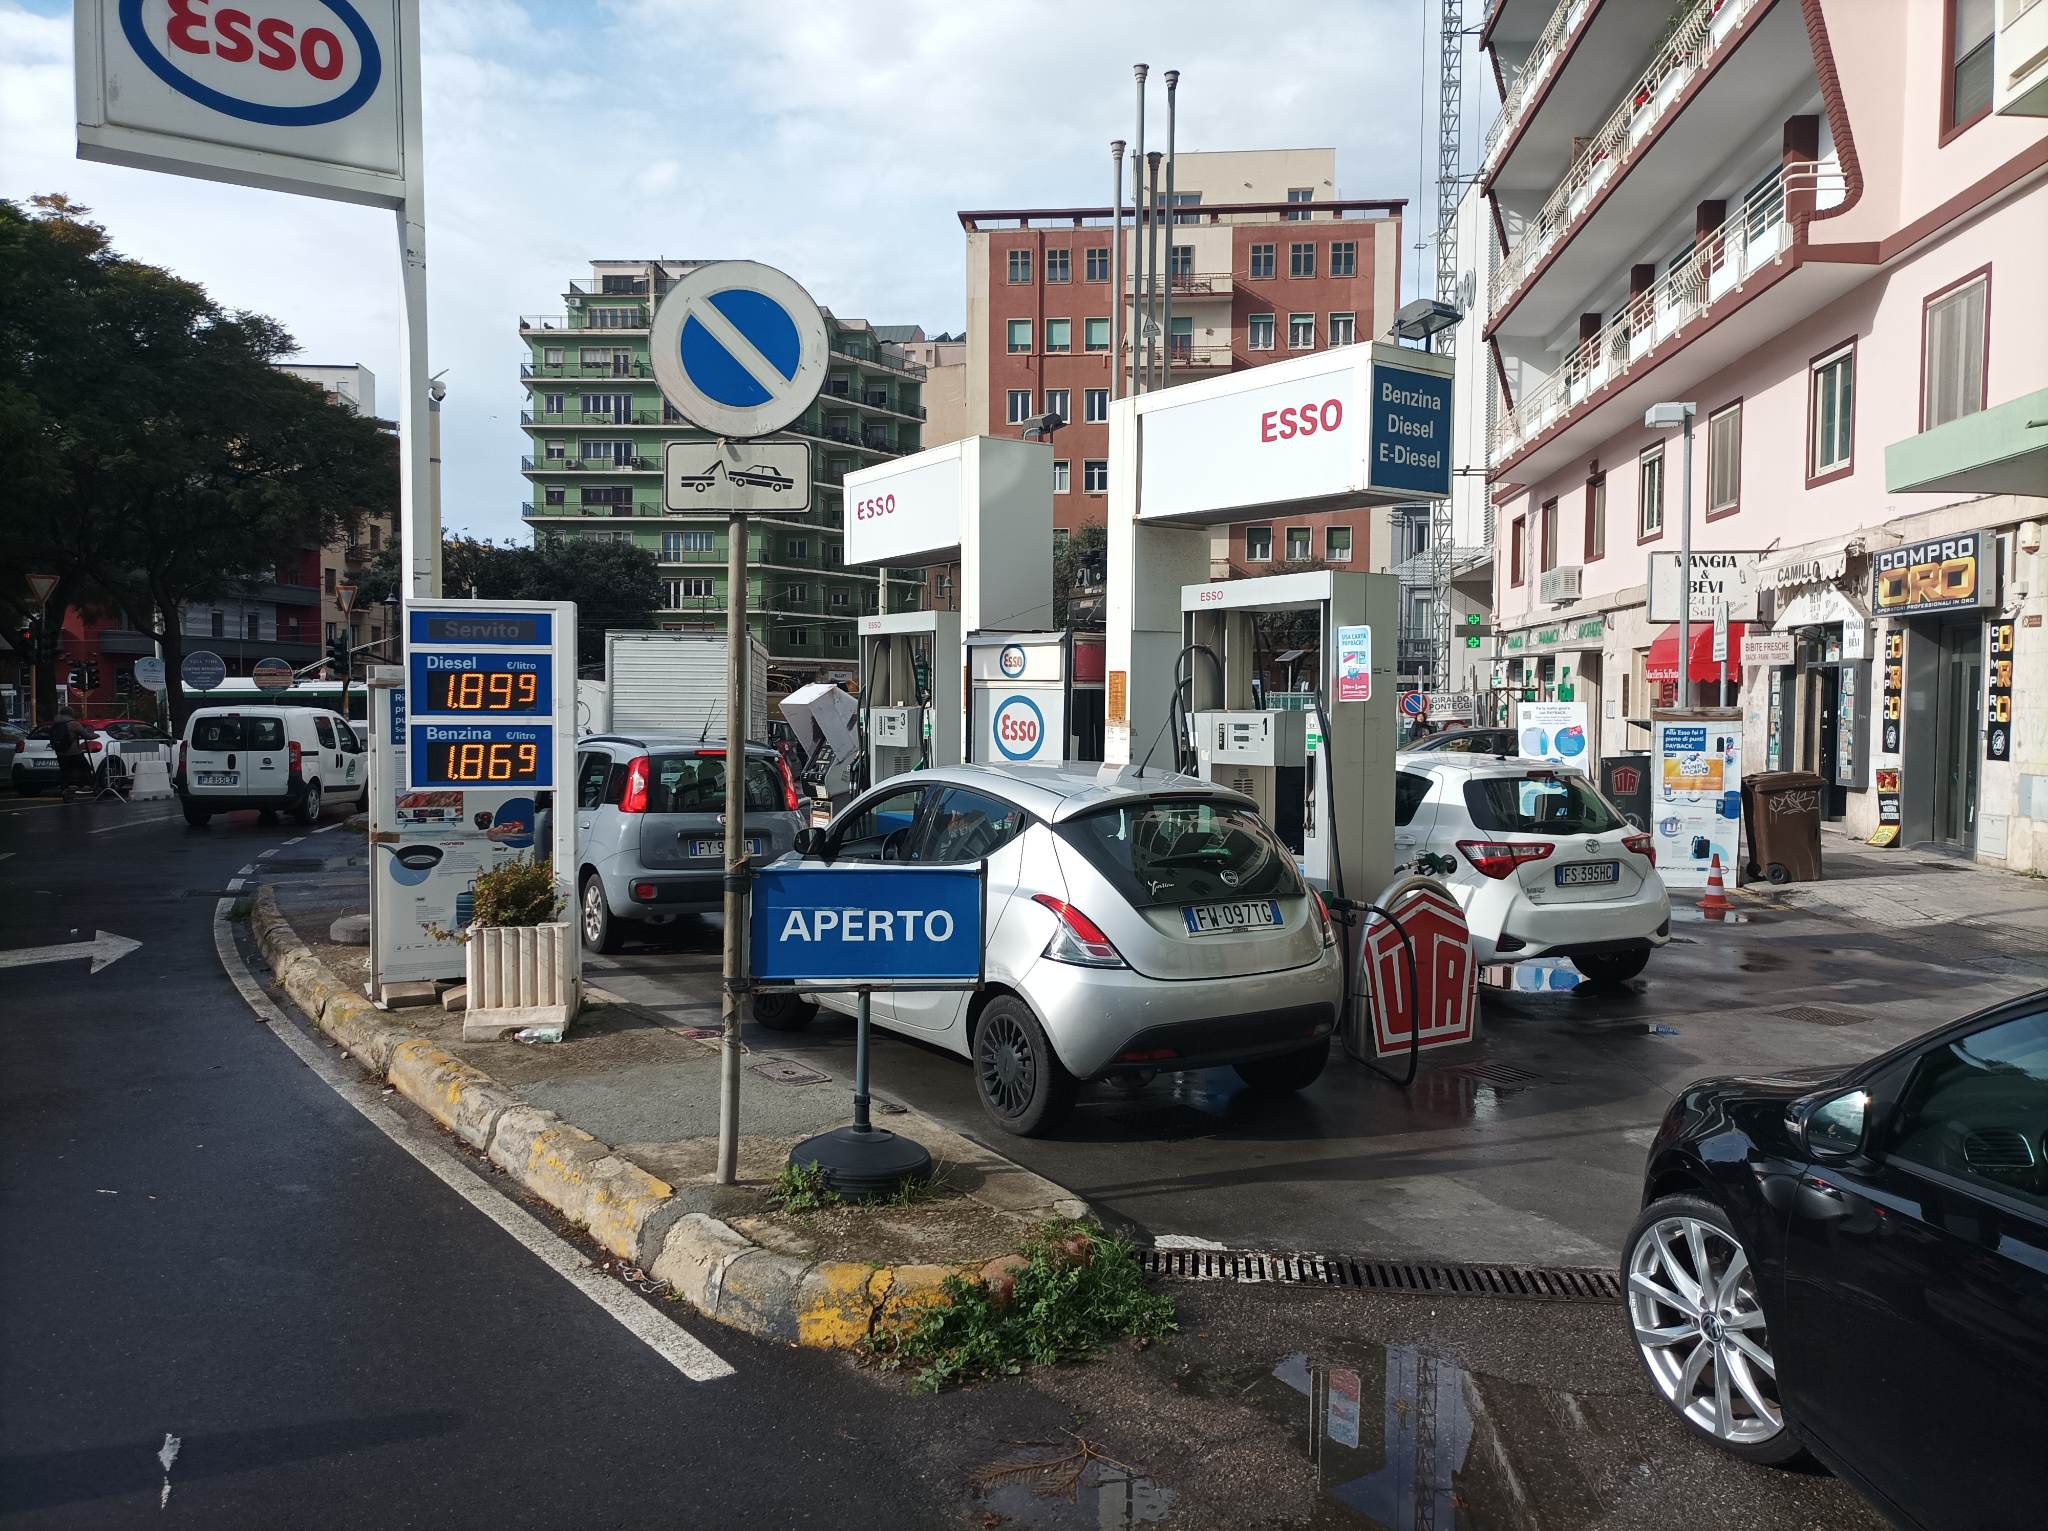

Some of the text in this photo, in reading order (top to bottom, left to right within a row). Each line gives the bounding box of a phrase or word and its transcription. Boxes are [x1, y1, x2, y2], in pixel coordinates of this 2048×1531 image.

[1382, 382, 1441, 411] Benzina
[1261, 398, 1343, 443] ESSO
[1387, 413, 1434, 439] Diesel
[1379, 442, 1441, 469] E-Diesel
[857, 493, 896, 521] ESSO
[1880, 537, 1974, 571] COMPRO
[1700, 570, 1710, 579] &
[1778, 561, 1820, 583] CAMILLO
[1689, 580, 1723, 593] BEVI
[1878, 556, 1975, 607] ORO
[1200, 591, 1224, 602] ESSO
[1906, 600, 1951, 610] PROFESSIONALI
[445, 620, 520, 639] Servito
[867, 620, 882, 630] ESSO
[1745, 641, 1790, 652] BIBITE FRESCHE
[426, 655, 537, 670] Diesel €/litro
[1429, 702, 1473, 711] PONTEGGI
[1431, 695, 1470, 704] GIRALDO
[900, 712, 906, 726] 3
[1262, 717, 1268, 735] 1
[426, 727, 536, 740] Benzina €/litro
[779, 909, 955, 942] APERTO
[1377, 908, 1470, 1035] UTA
